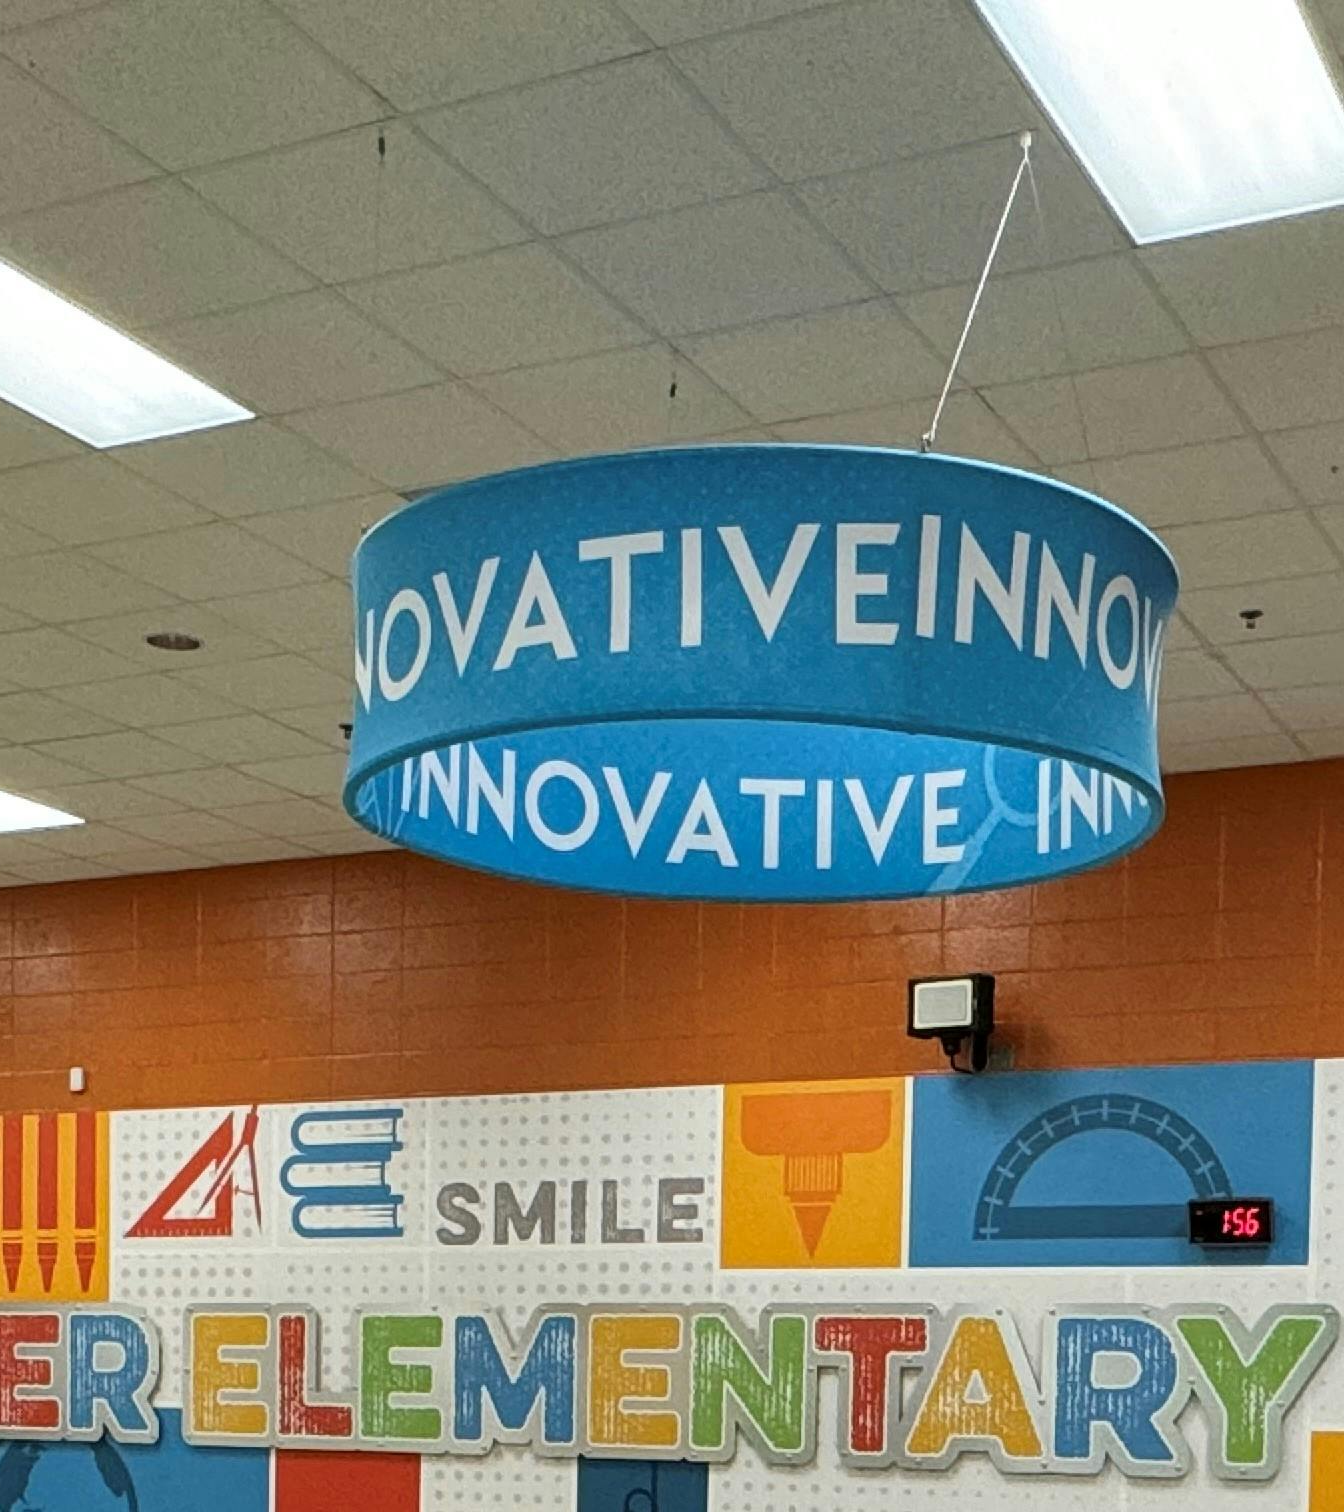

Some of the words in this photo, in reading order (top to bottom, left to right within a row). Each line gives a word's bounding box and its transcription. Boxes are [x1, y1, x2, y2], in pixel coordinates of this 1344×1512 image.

[401, 741, 967, 869] INNOVATIVE
[436, 1178, 705, 1246] SMILE
[189, 1312, 1329, 1467] ELEMENTARY
